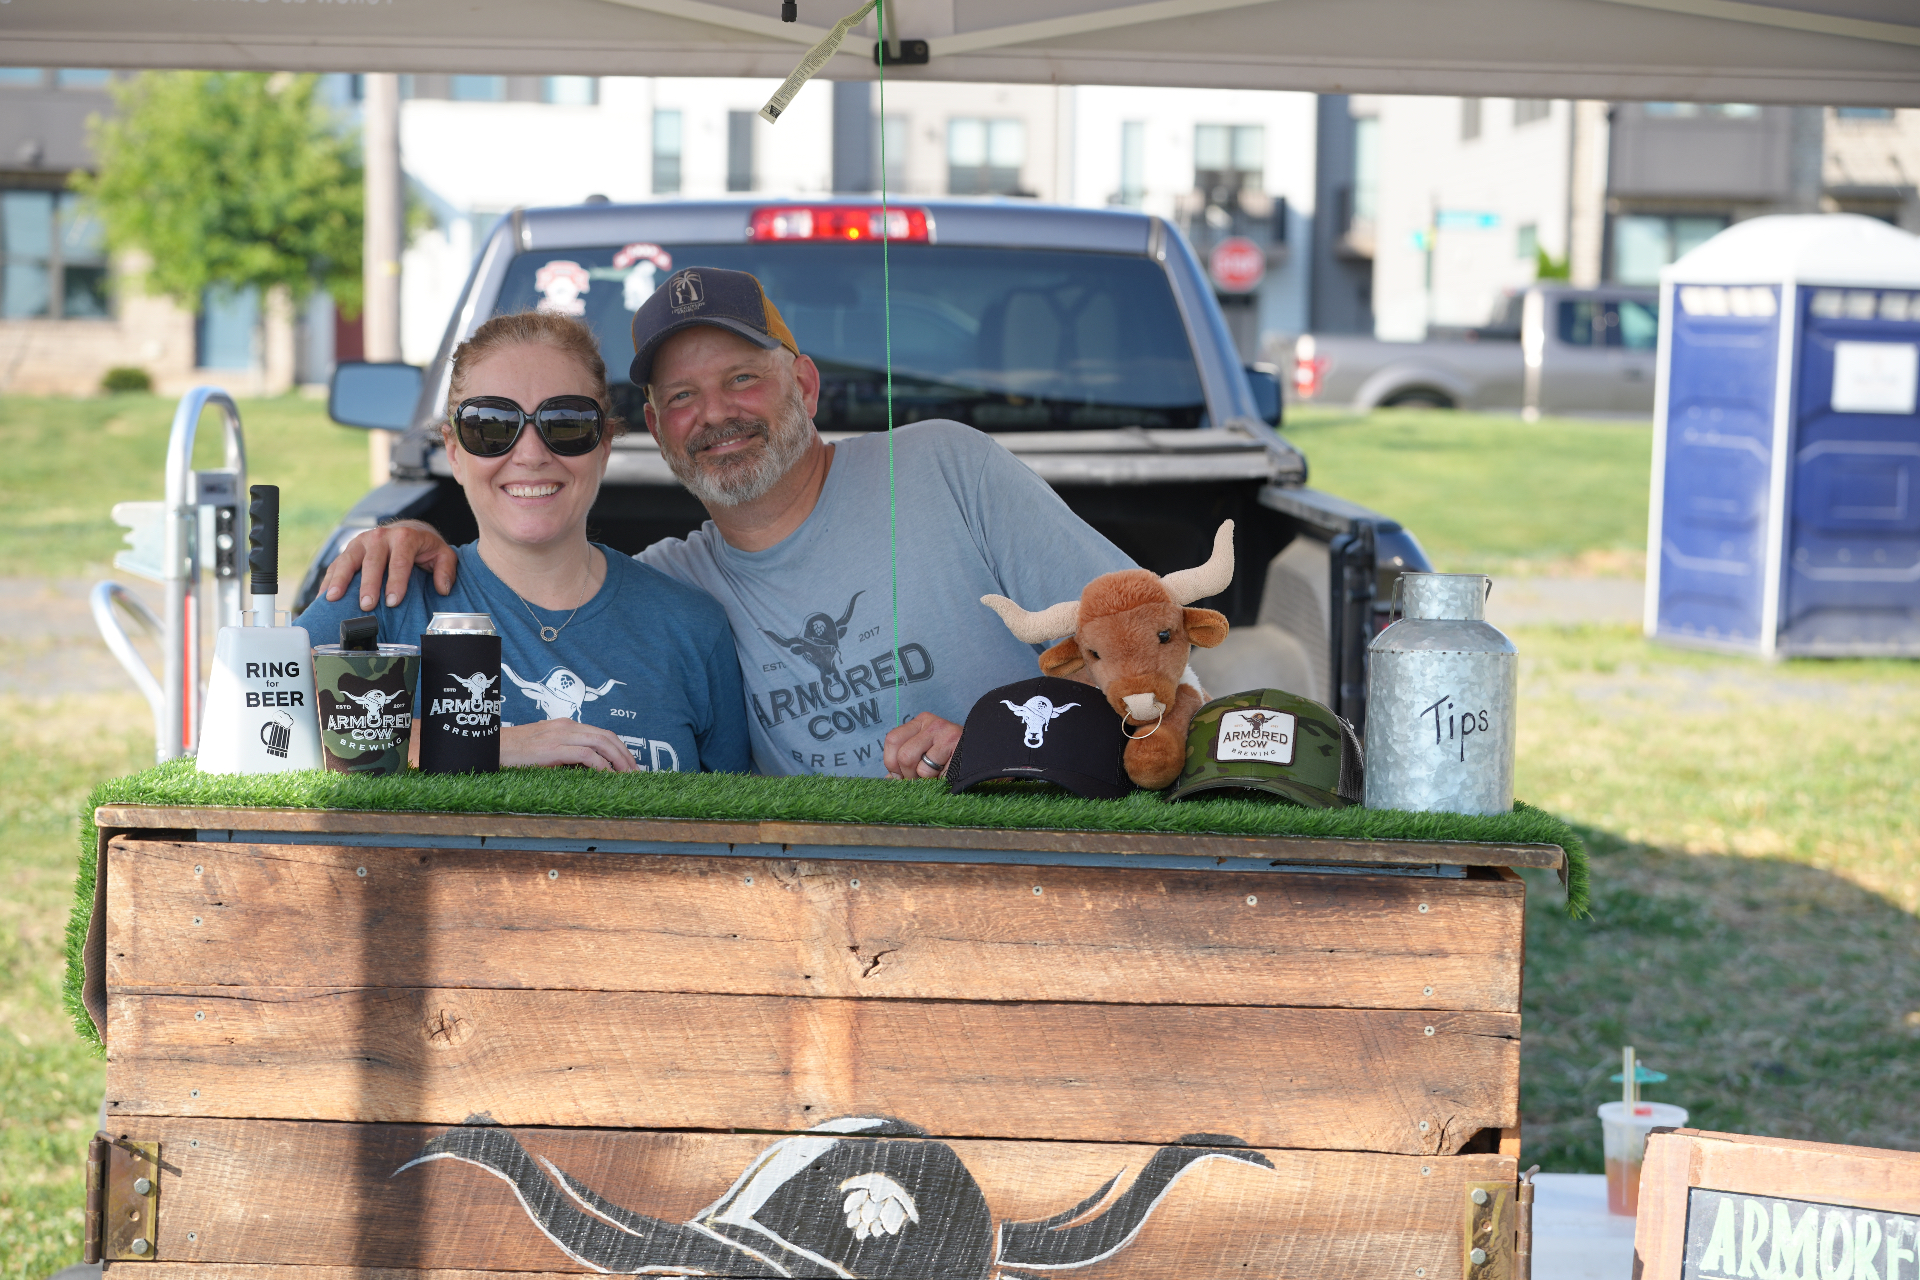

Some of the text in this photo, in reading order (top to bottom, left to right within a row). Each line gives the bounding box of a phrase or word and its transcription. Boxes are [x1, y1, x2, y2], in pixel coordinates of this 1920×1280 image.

[858, 626, 881, 642] 2017
[246, 661, 300, 678] RING
[751, 642, 935, 729] ARMORED
[246, 691, 304, 707] BEER
[429, 698, 501, 716] ARMORE
[327, 713, 412, 731] ARMORED
[455, 713, 492, 725] COW
[610, 708, 637, 720] 2017
[807, 698, 882, 741] COW
[351, 728, 394, 740] COW
[442, 723, 499, 738] BREWING
[1420, 695, 1489, 762] Tips
[340, 737, 402, 751] BREWING
[1223, 731, 1289, 745] ARMORED
[1240, 740, 1268, 748] COW
[1231, 748, 1276, 757] BREWING
[1699, 1197, 1920, 1280] ARMORE
